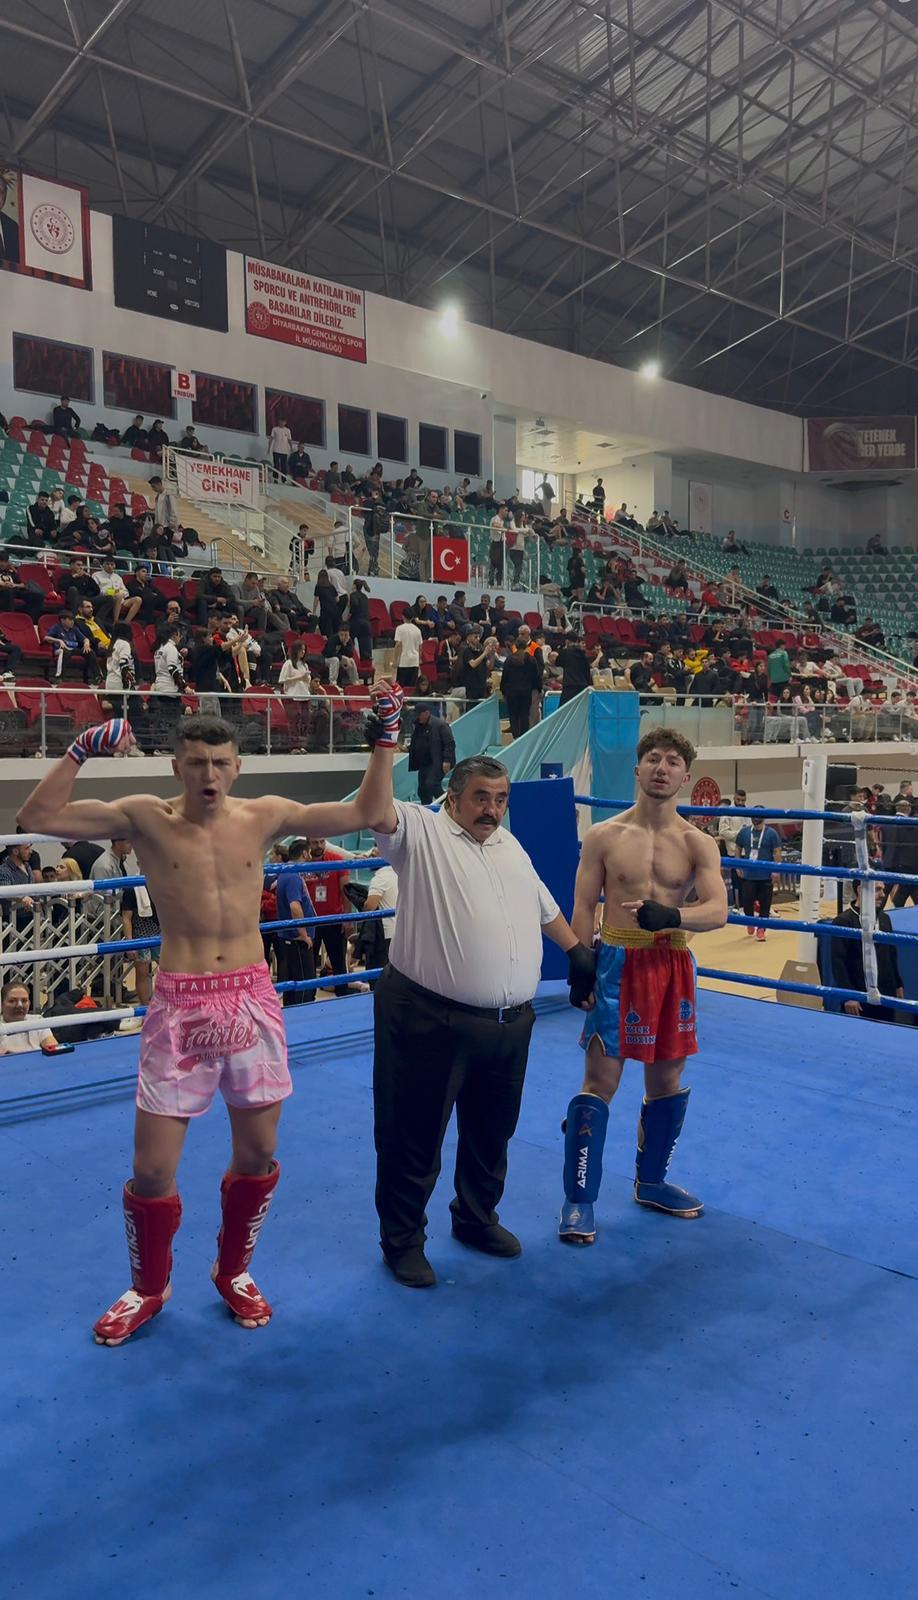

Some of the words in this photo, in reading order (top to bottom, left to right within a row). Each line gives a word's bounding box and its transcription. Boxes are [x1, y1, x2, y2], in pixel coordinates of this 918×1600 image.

[247, 262, 311, 291] MÜSABAKALARA
[313, 281, 344, 300] KATILAN
[346, 290, 361, 305] TÜM
[253, 279, 286, 298] SPORCU
[288, 289, 297, 301] VE
[299, 293, 357, 318] ANTRENÖRLERE
[268, 299, 312, 321] BAŞARILAR
[313, 310, 344, 330] DİLERİZ.
[272, 318, 311, 334] DİYARBAKIR
[311, 328, 338, 342] GENÇLİK
[339, 335, 346, 345] VE
[347, 338, 363, 348] SPOR
[178, 373, 191, 390] B
[190, 462, 251, 481] YEMEKHANE
[180, 975, 251, 992] FAIRTEX
[625, 1034, 656, 1045] BOXIN
[577, 1146, 589, 1189] ARIMA
